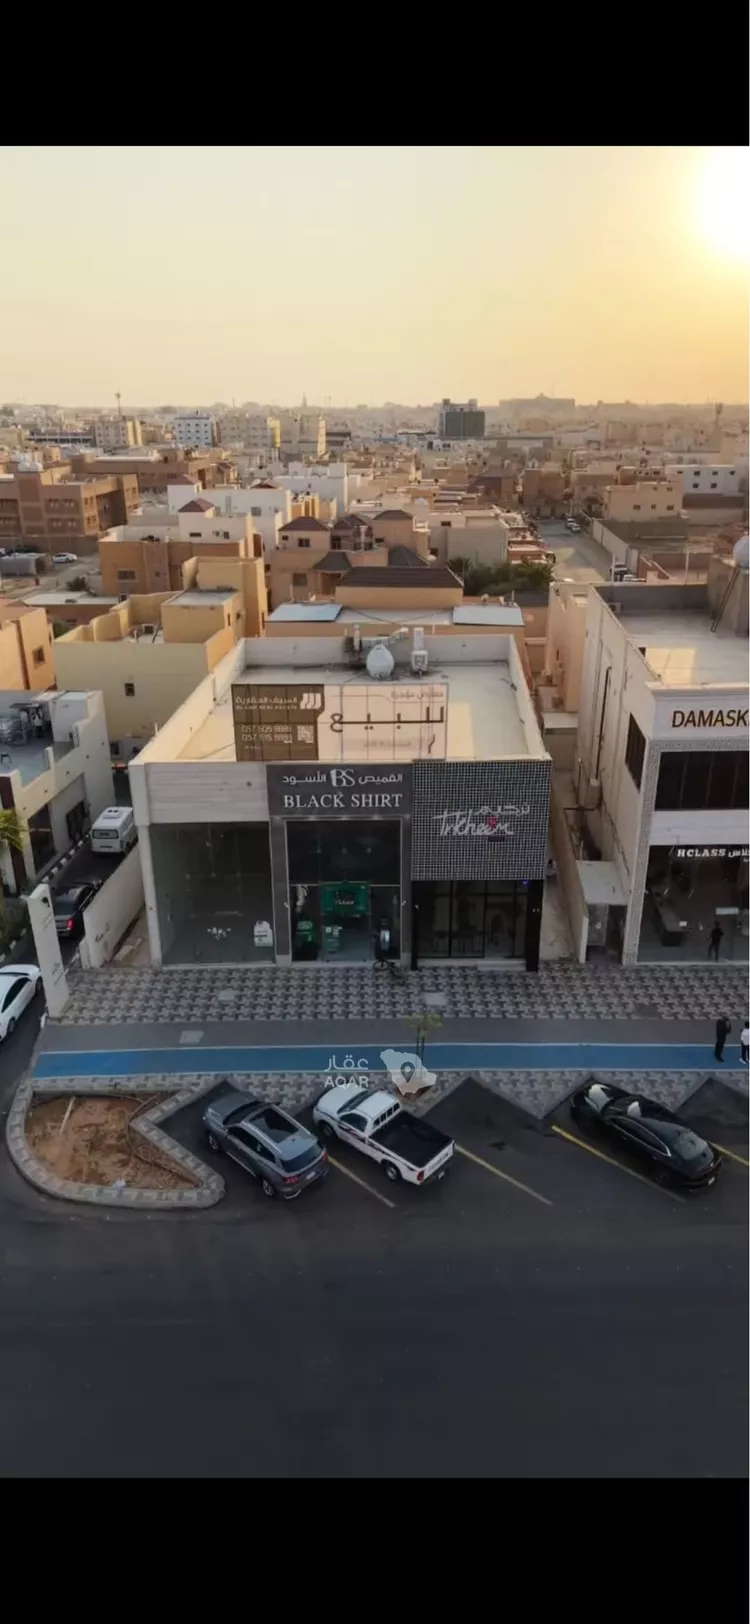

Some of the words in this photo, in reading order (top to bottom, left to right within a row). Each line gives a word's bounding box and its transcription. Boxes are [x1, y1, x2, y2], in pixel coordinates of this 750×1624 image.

[330, 706, 444, 733] للبيع
[282, 770, 327, 786] الأسود
[330, 768, 355, 787] BS
[358, 773, 403, 785] القميص
[284, 793, 346, 808] BLACK
[351, 794, 403, 808] SHIRT
[677, 848, 726, 858] HCLASS
